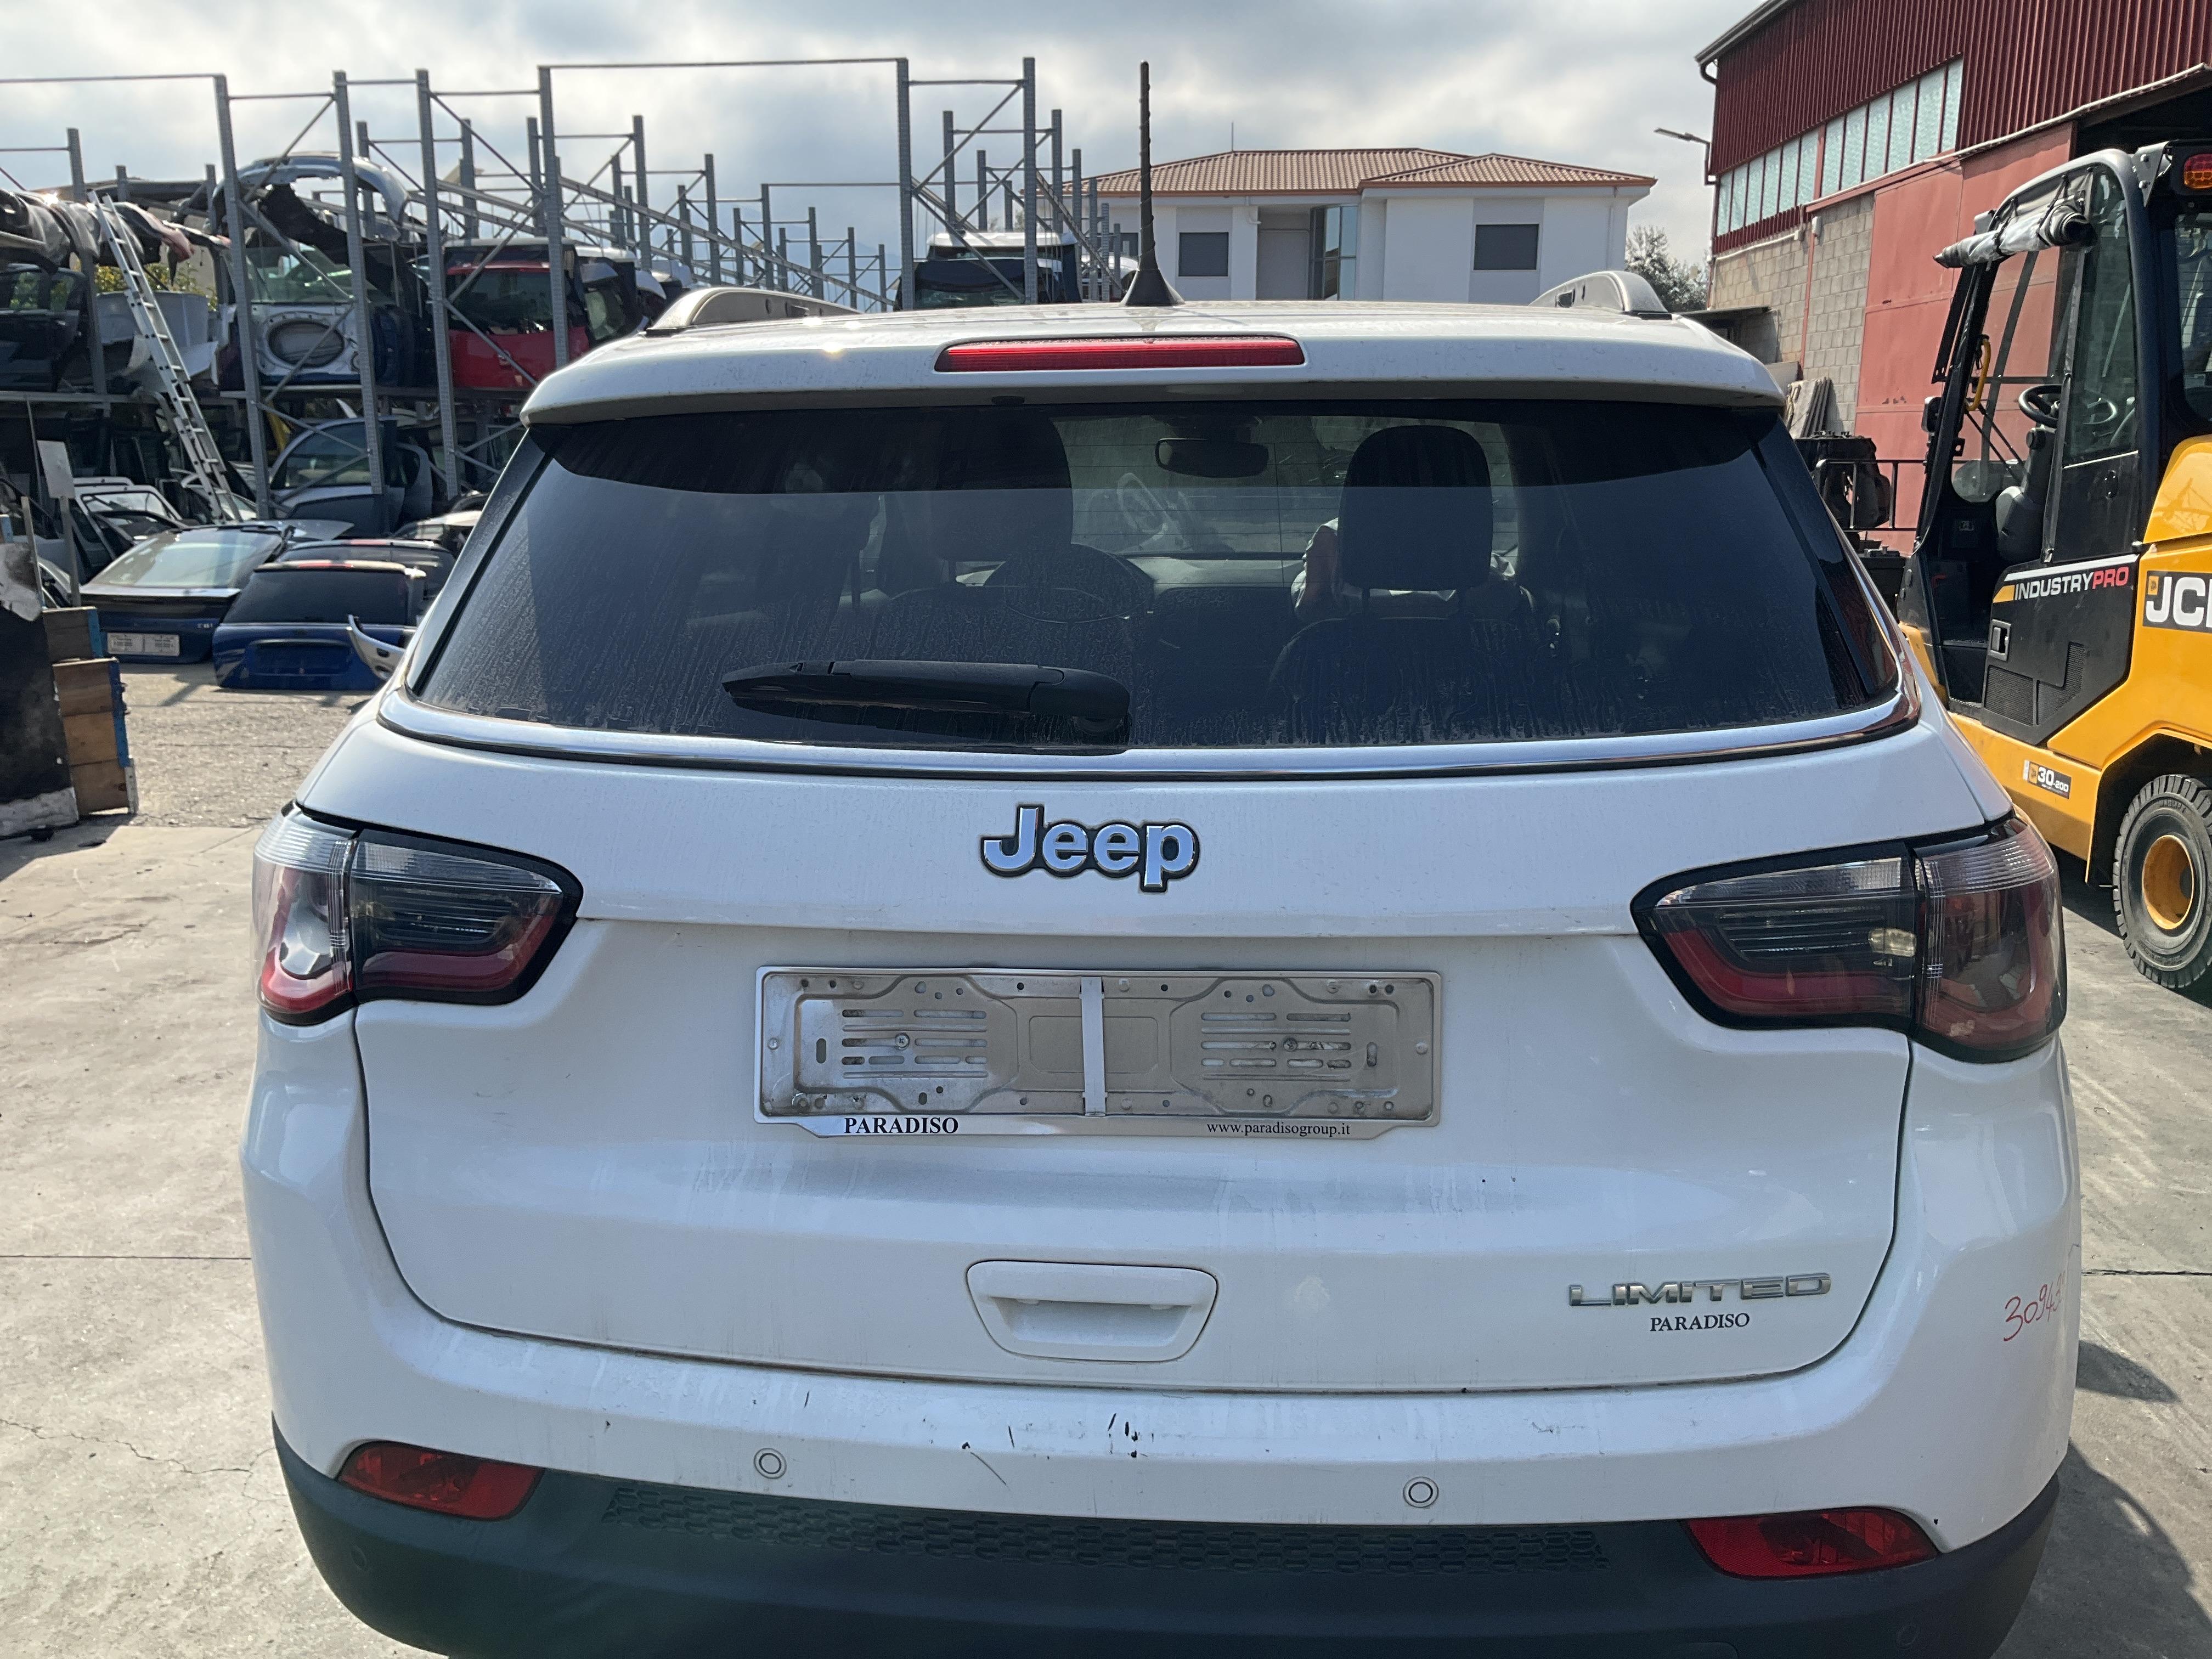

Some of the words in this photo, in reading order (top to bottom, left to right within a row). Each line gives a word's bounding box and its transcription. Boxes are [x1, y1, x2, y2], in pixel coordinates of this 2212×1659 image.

[2015, 566, 2129, 600] INDUSTRYPRO
[981, 805, 1199, 892] Jeep
[844, 1117, 958, 1133] PARADISO
[1206, 1121, 1351, 1137] www.paradisogroup.it
[1569, 1272, 1831, 1306] LIMITED
[1650, 1312, 1750, 1331] PARADISO
